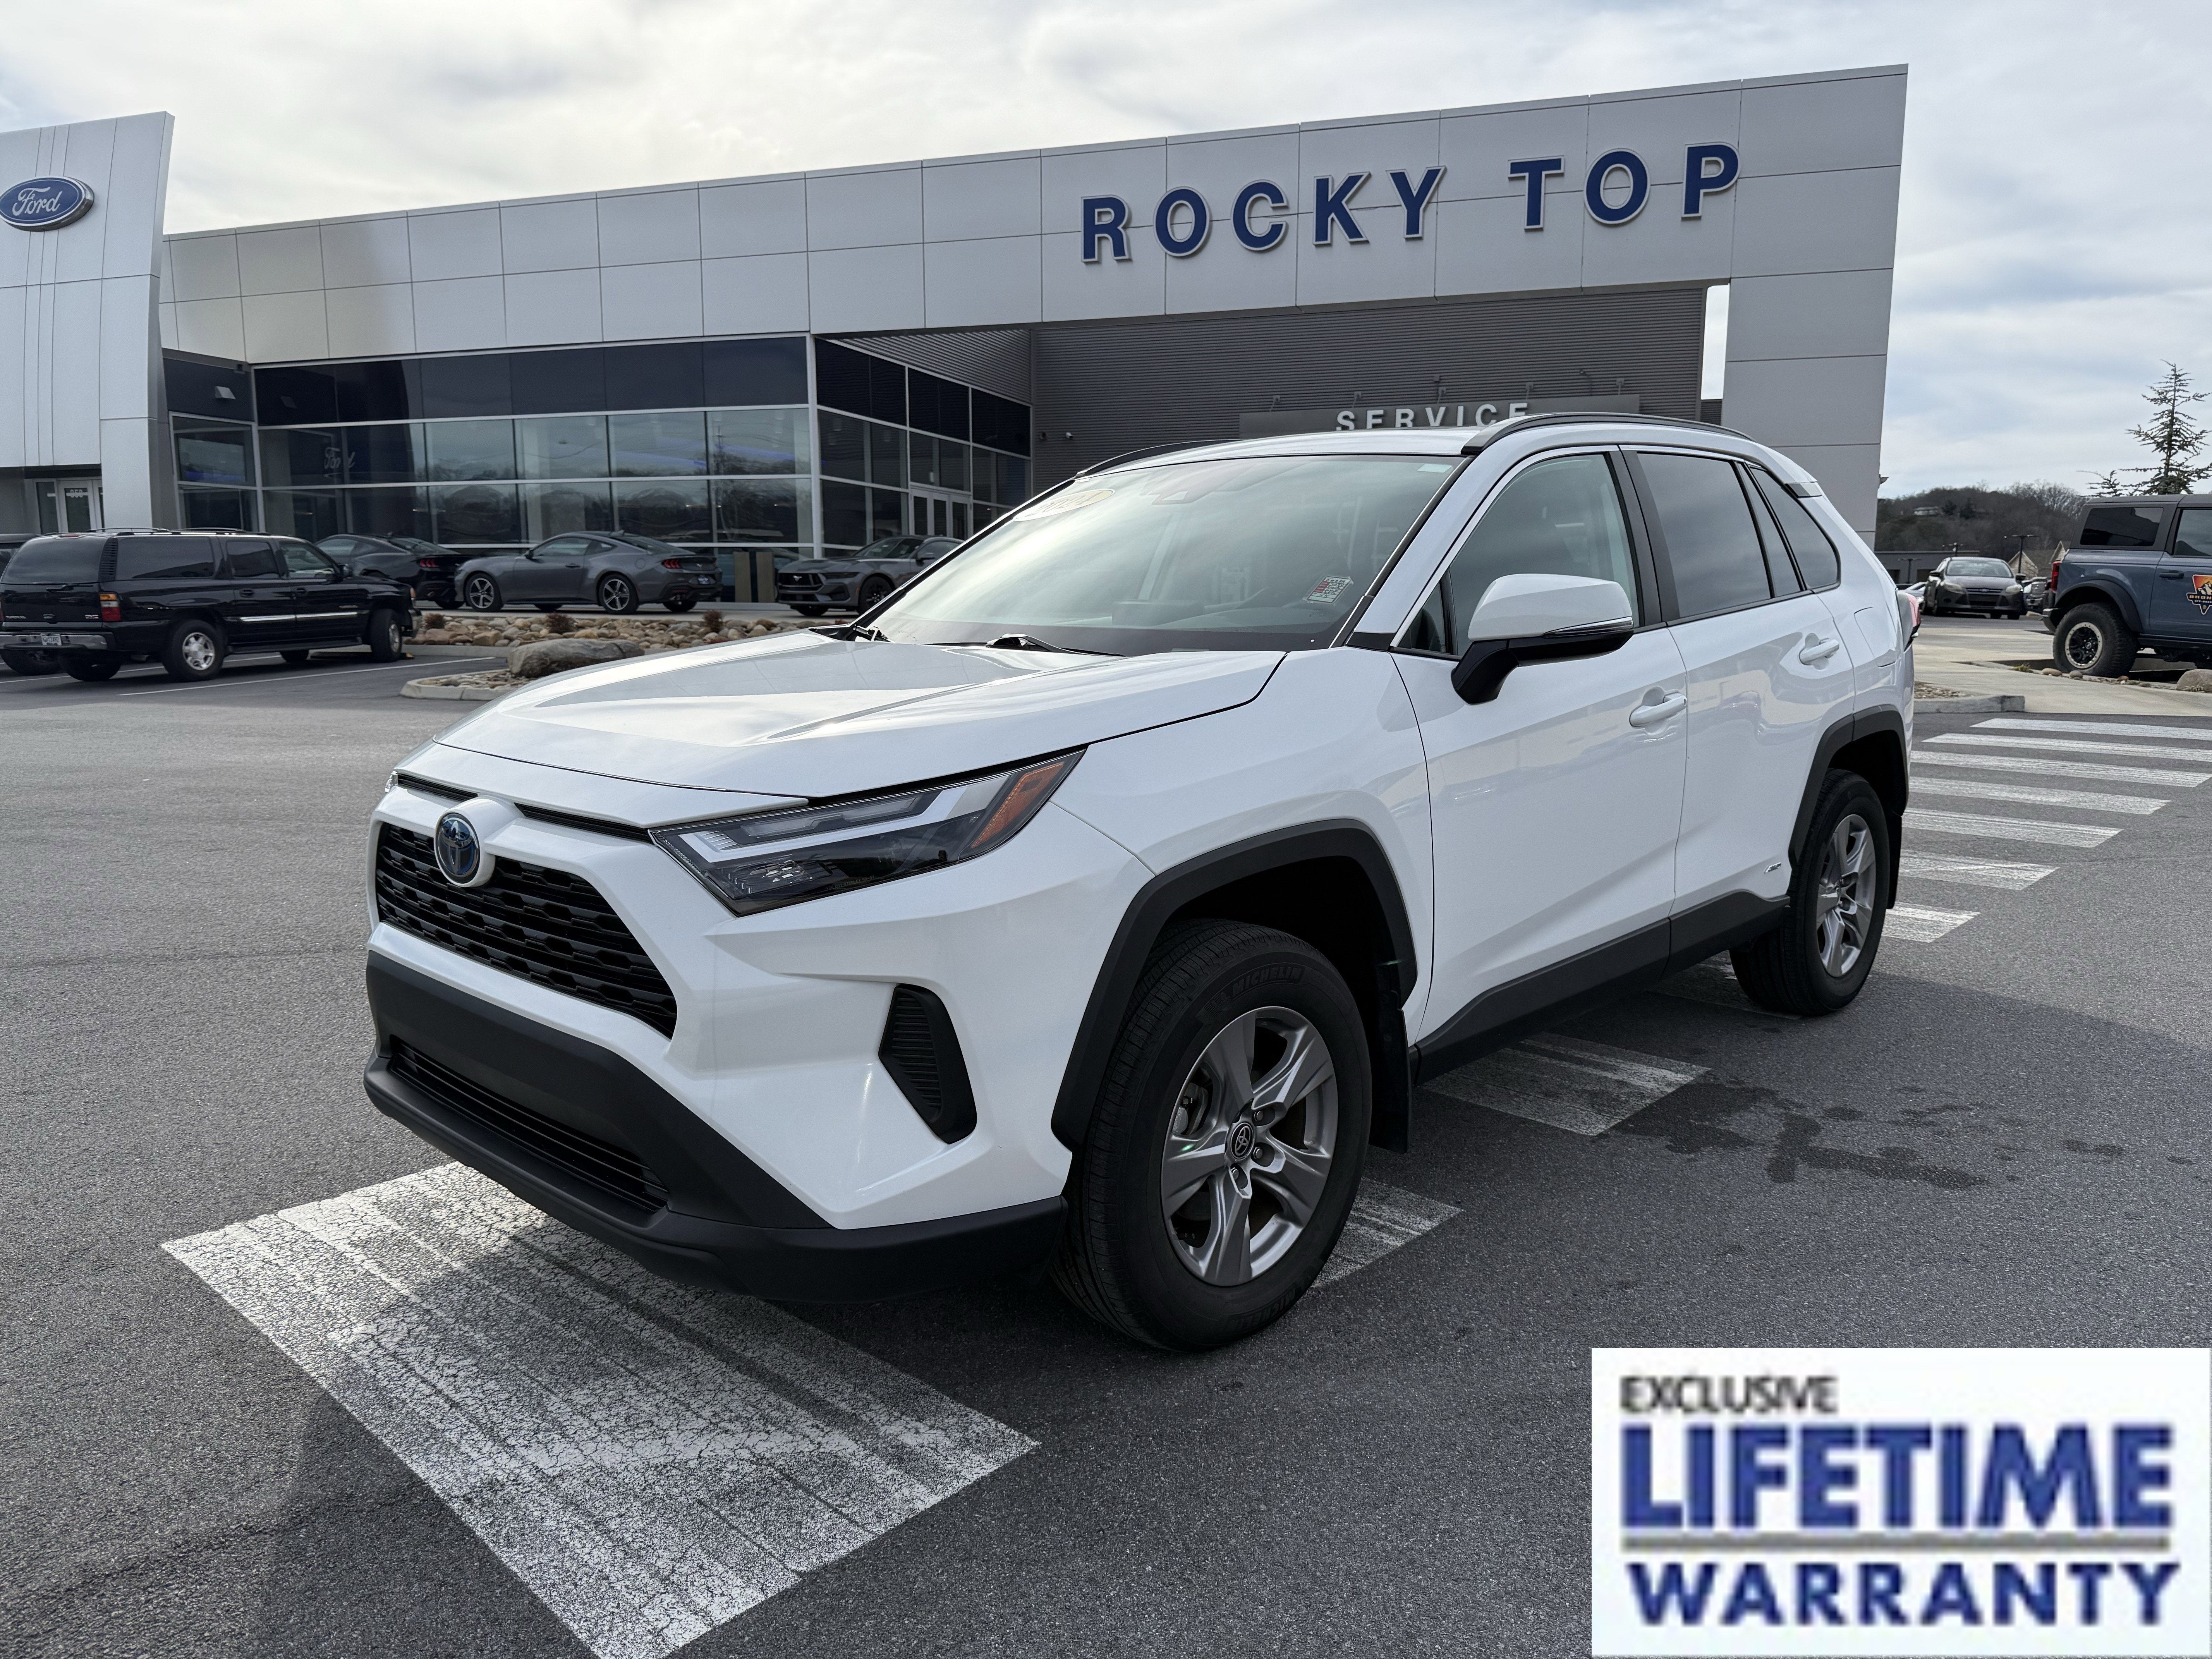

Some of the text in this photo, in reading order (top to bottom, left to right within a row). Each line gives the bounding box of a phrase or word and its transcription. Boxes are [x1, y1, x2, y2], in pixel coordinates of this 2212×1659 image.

[12, 187, 63, 216] Ford
[1080, 141, 1741, 264] ROCKY TOP
[1336, 403, 1528, 431] SERVICE
[1232, 967, 1303, 997] MICHELIN
